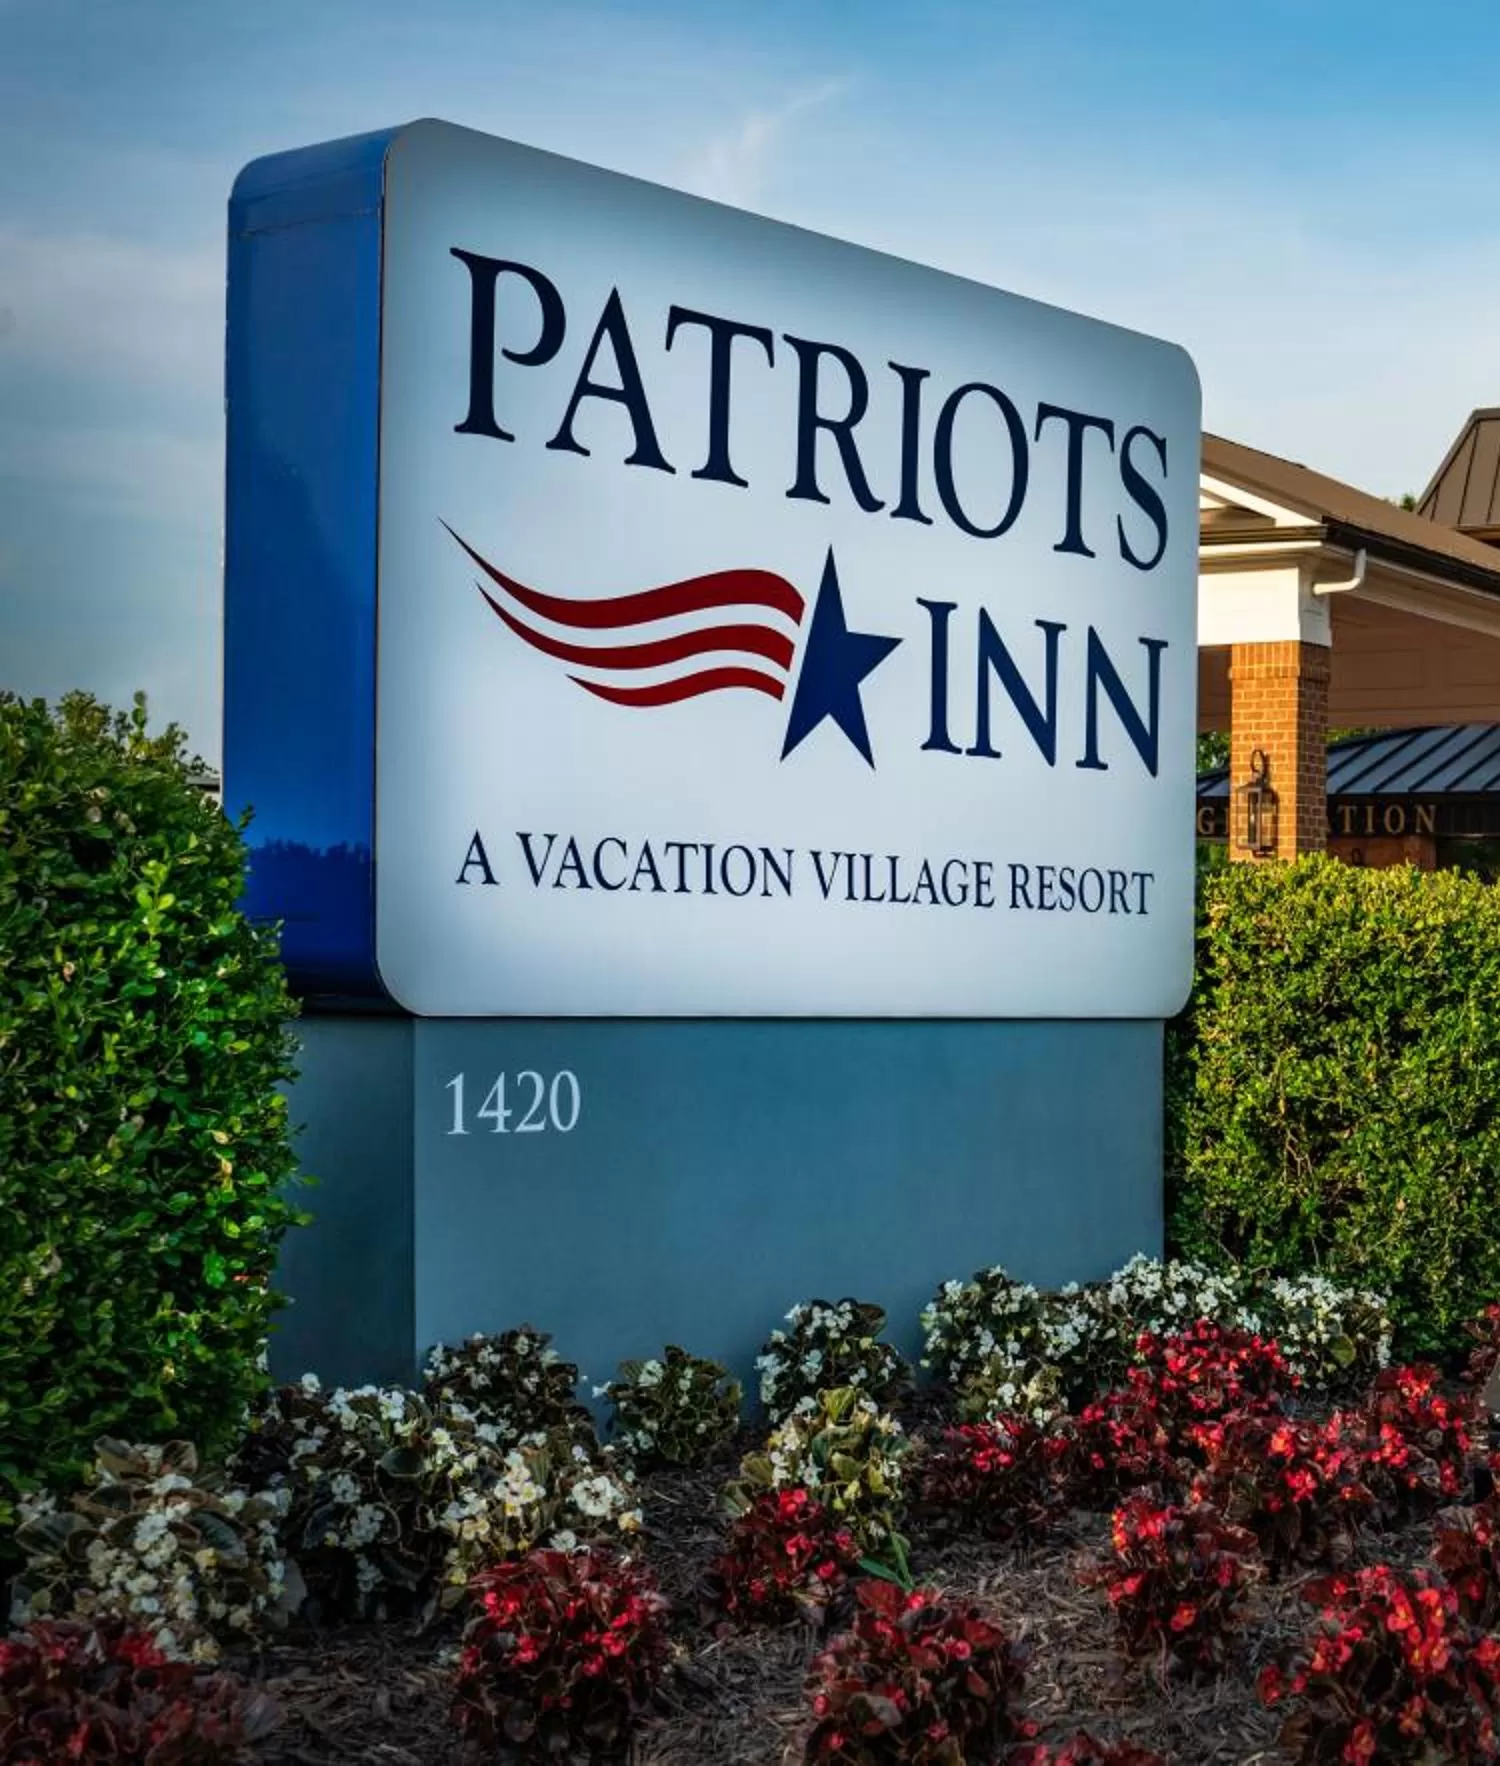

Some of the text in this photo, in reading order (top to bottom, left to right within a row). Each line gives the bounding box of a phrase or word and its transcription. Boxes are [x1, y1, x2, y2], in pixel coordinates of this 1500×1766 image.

[448, 246, 1169, 572] PATRIOTS
[915, 597, 1169, 779] INN
[455, 829, 1156, 916] A VACATION VILLAGE RESORT
[444, 1070, 581, 1136] 1420
